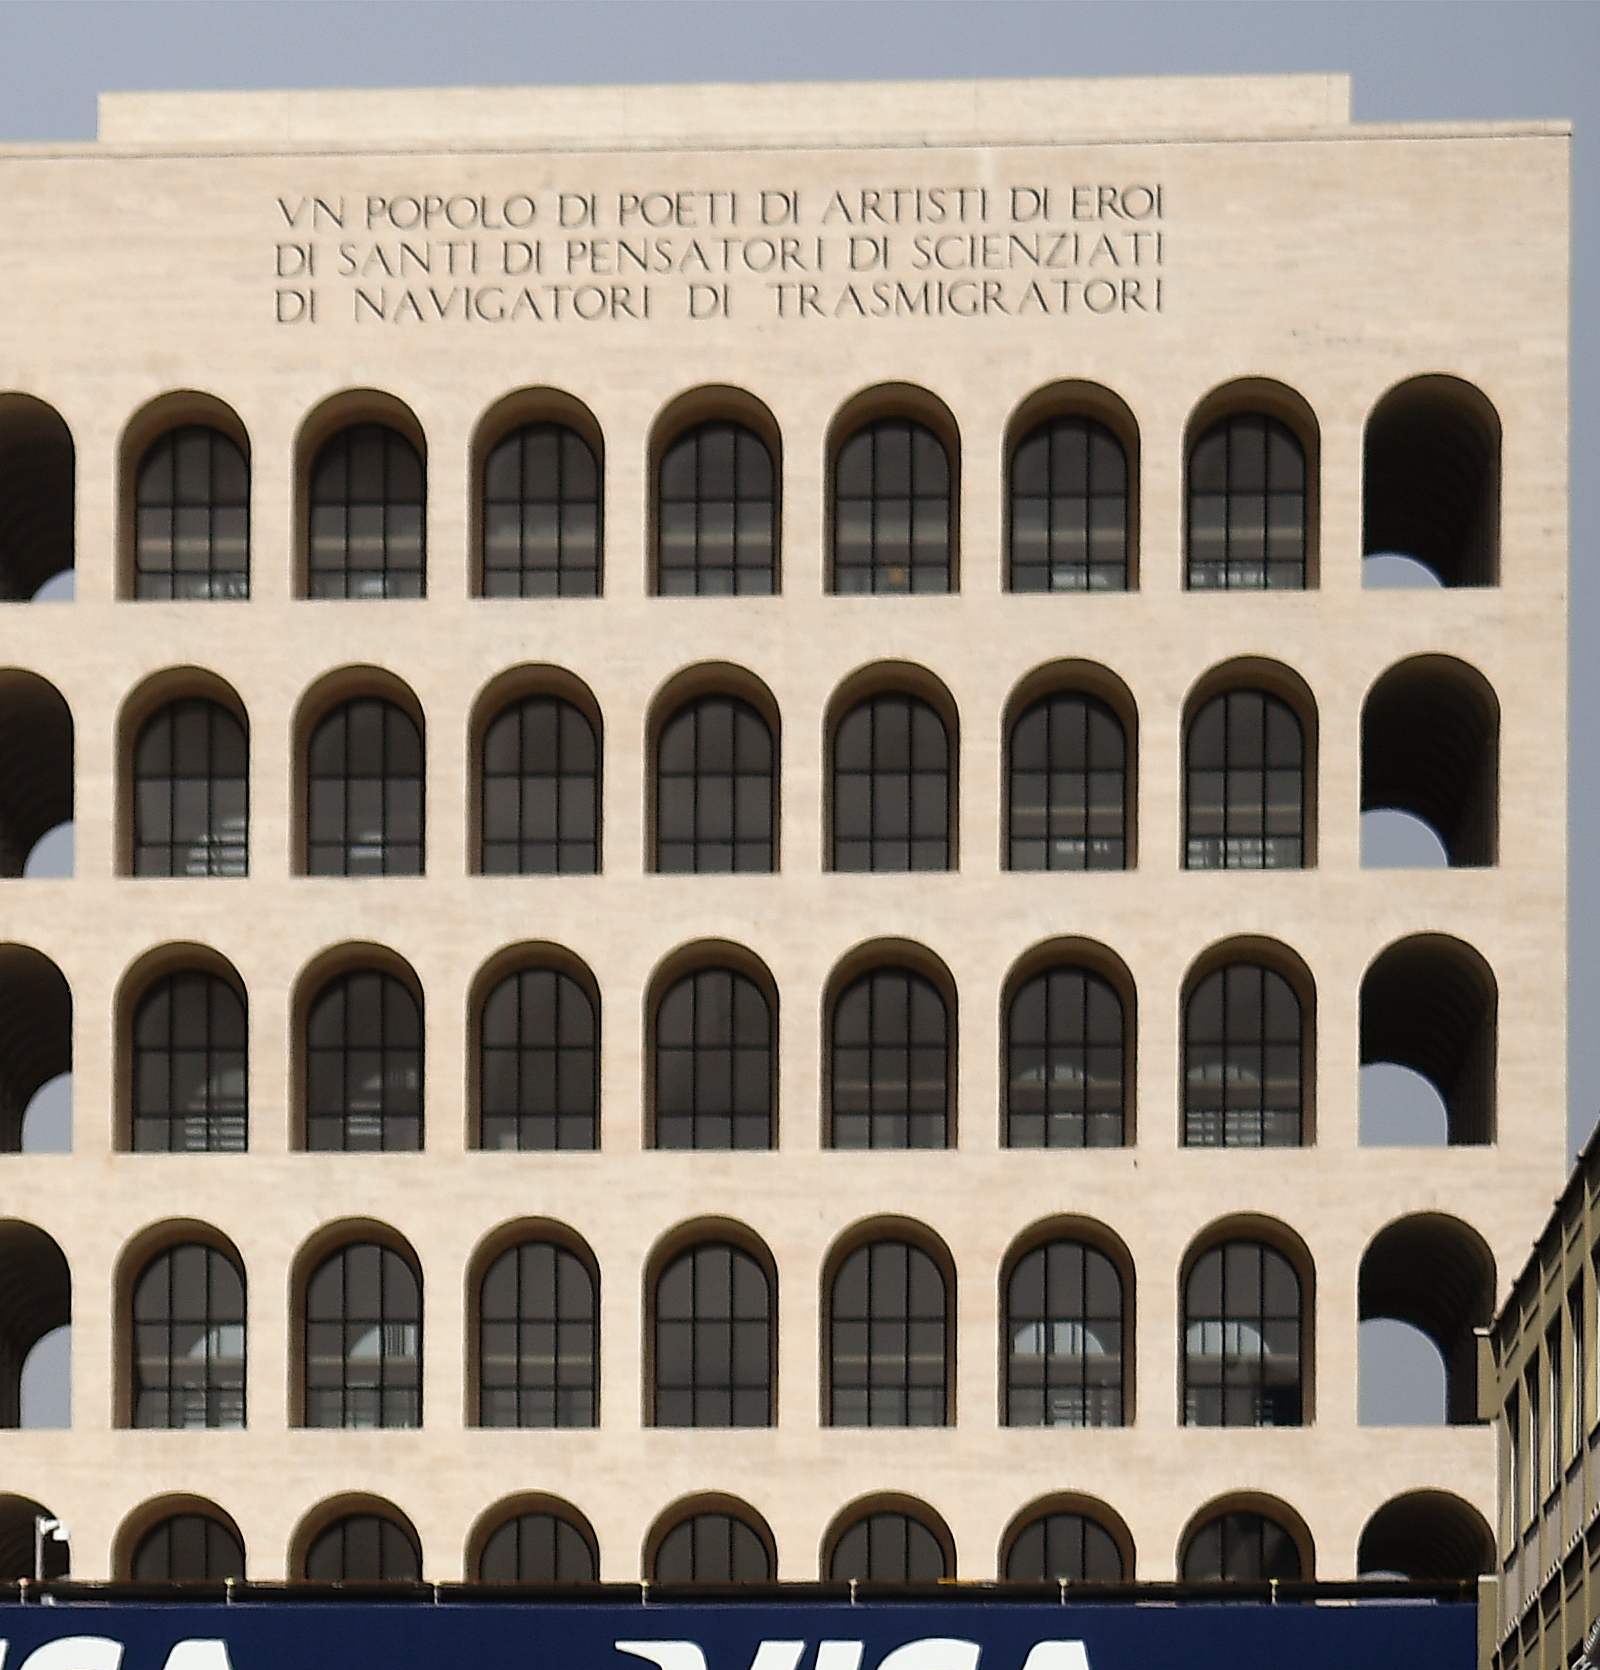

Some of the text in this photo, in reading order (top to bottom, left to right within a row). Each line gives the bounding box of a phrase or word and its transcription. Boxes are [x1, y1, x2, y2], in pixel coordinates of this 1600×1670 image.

[277, 183, 1163, 231] VN POPOLO DI POETI DI ARTISTI DI EROI
[274, 232, 1163, 279] DI SANTI DI PENSATORI DI SCIENZIATI
[274, 279, 1163, 325] DI NAVIGATORI DI TRASMIGRATORI
